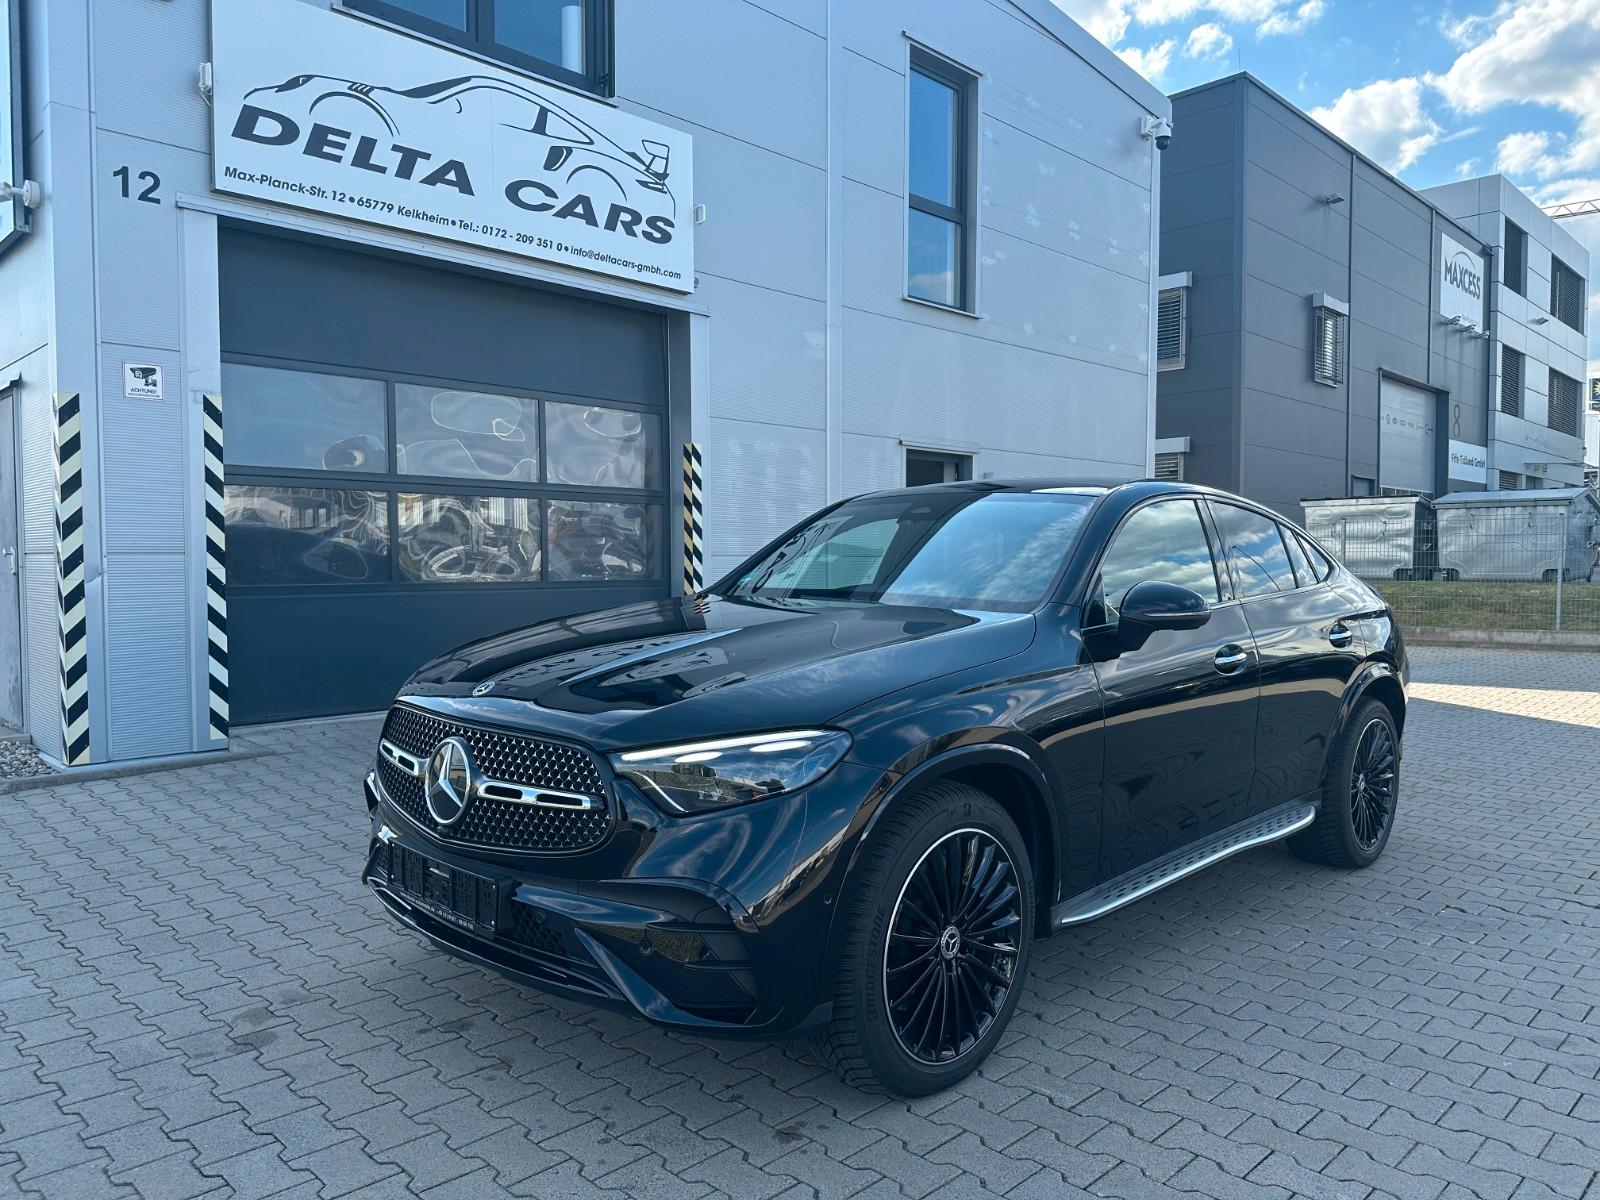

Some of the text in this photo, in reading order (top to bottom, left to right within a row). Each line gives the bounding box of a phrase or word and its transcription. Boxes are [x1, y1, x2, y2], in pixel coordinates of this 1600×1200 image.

[113, 166, 161, 205] 12
[231, 104, 675, 244] DELTA CARS
[224, 166, 328, 199] Max-Planck-Str.
[397, 205, 449, 226] Kelkheim
[482, 225, 507, 239] 0172
[516, 233, 534, 245] 209
[536, 238, 553, 249] 351
[570, 245, 681, 280] info@deltacars-gmbh.com
[1444, 257, 1481, 300] MAXCESS
[1452, 403, 1461, 438] 8
